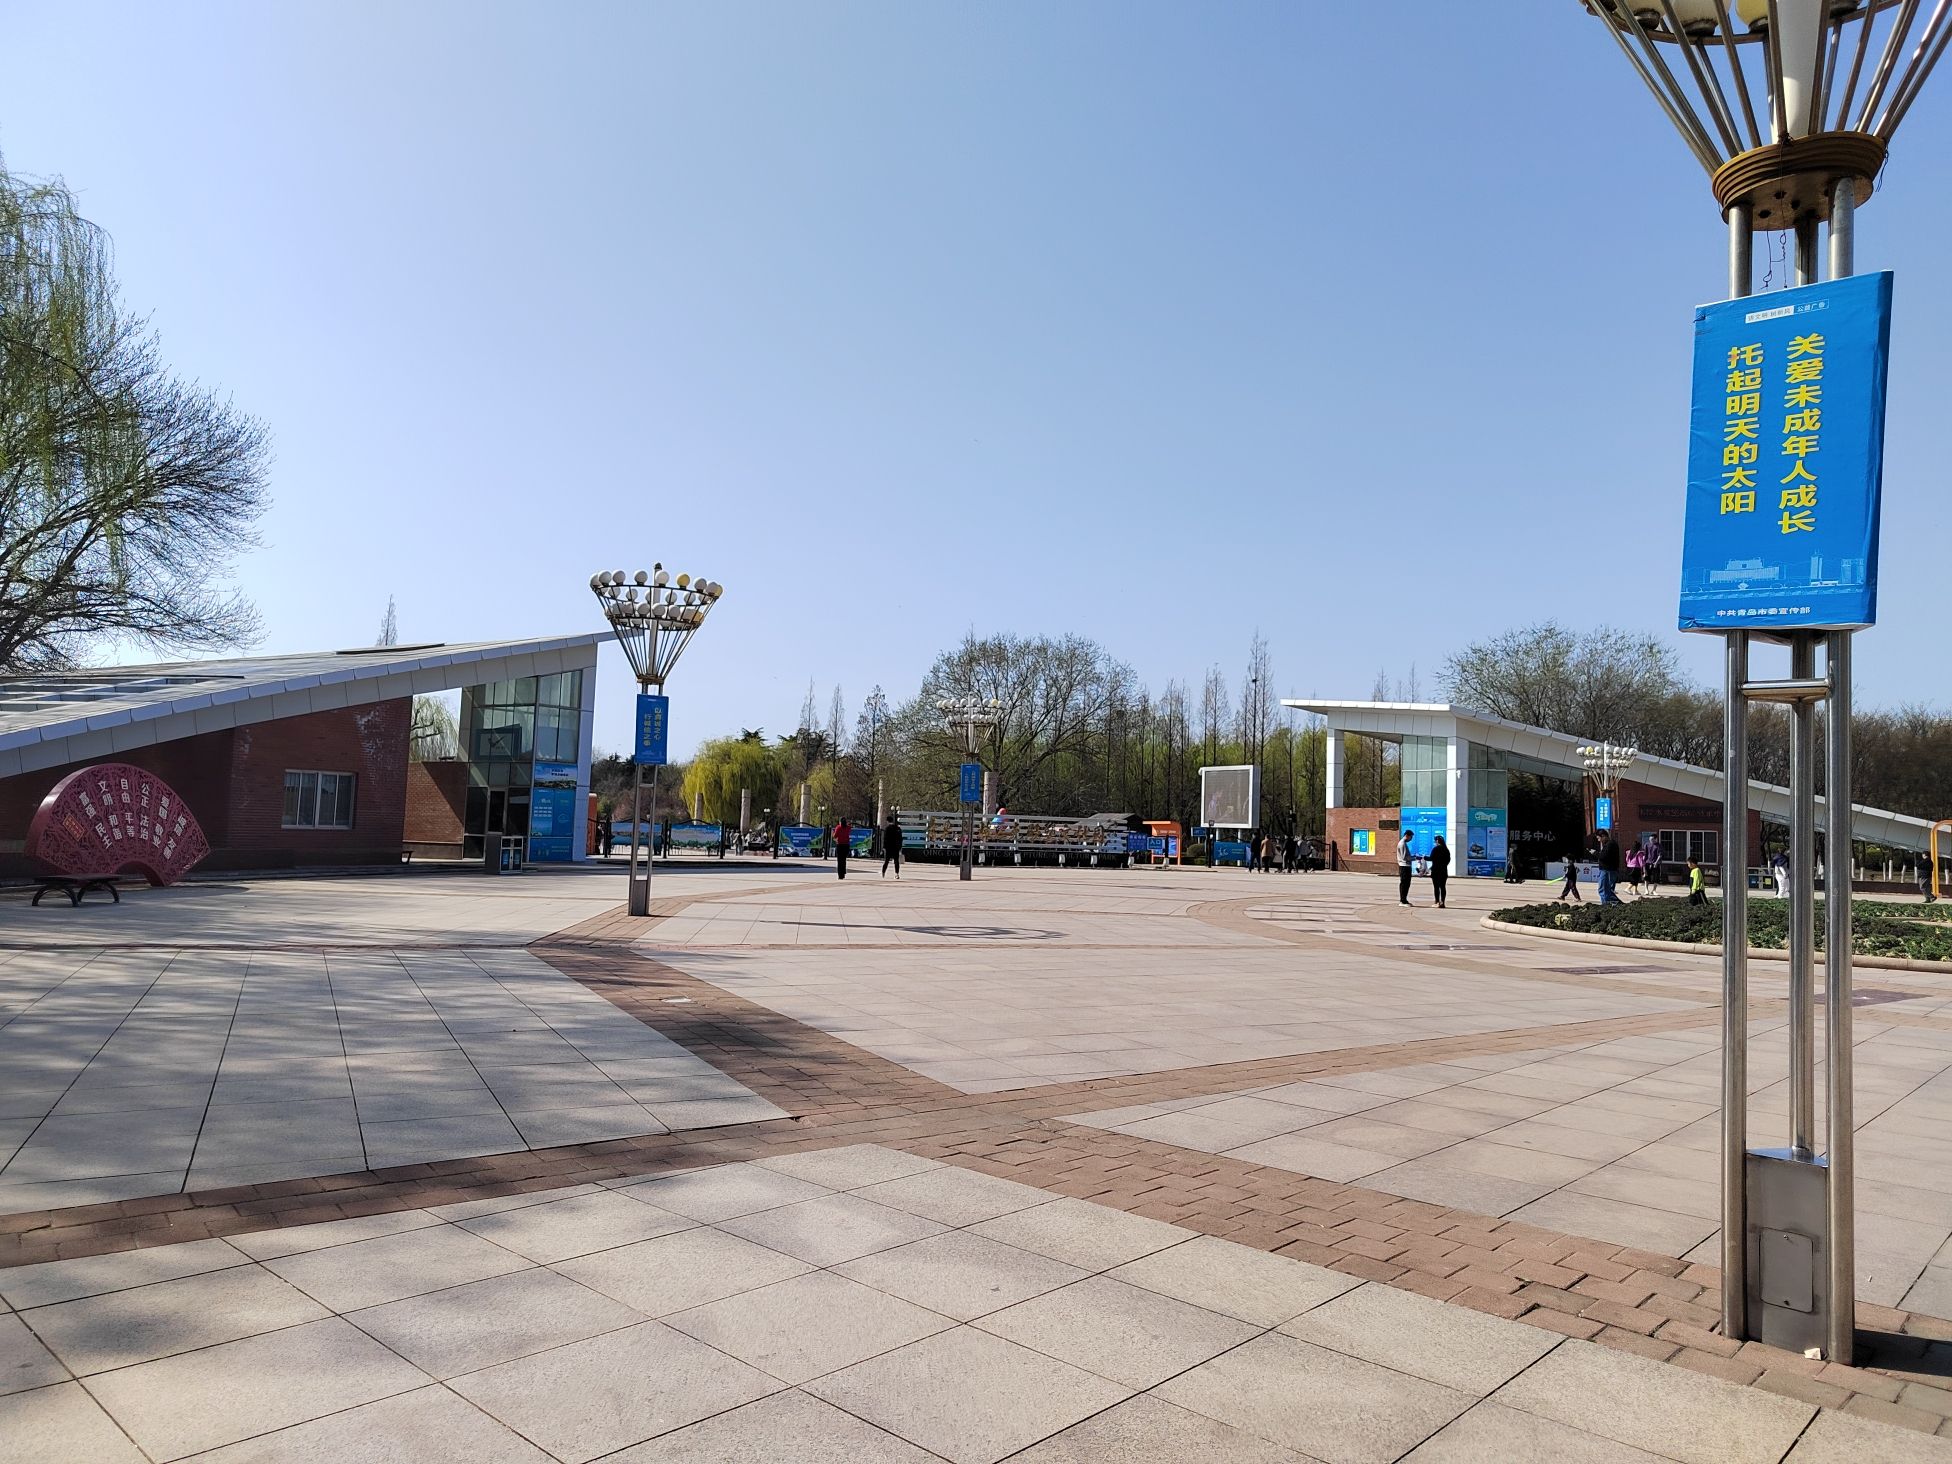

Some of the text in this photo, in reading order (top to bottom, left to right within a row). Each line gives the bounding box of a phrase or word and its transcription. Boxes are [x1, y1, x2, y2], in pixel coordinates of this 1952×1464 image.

[1720, 343, 1764, 515] 托起明天的太阳
[1778, 333, 1825, 534] 关爱未成年人成长
[1716, 606, 1811, 617] 中共青岛市委宣传部
[98, 780, 113, 806] 文明
[120, 778, 135, 837] 自由 平等
[140, 782, 150, 840] 公正 法治
[95, 822, 113, 849] 民主
[1509, 830, 1556, 841] 服务中心
